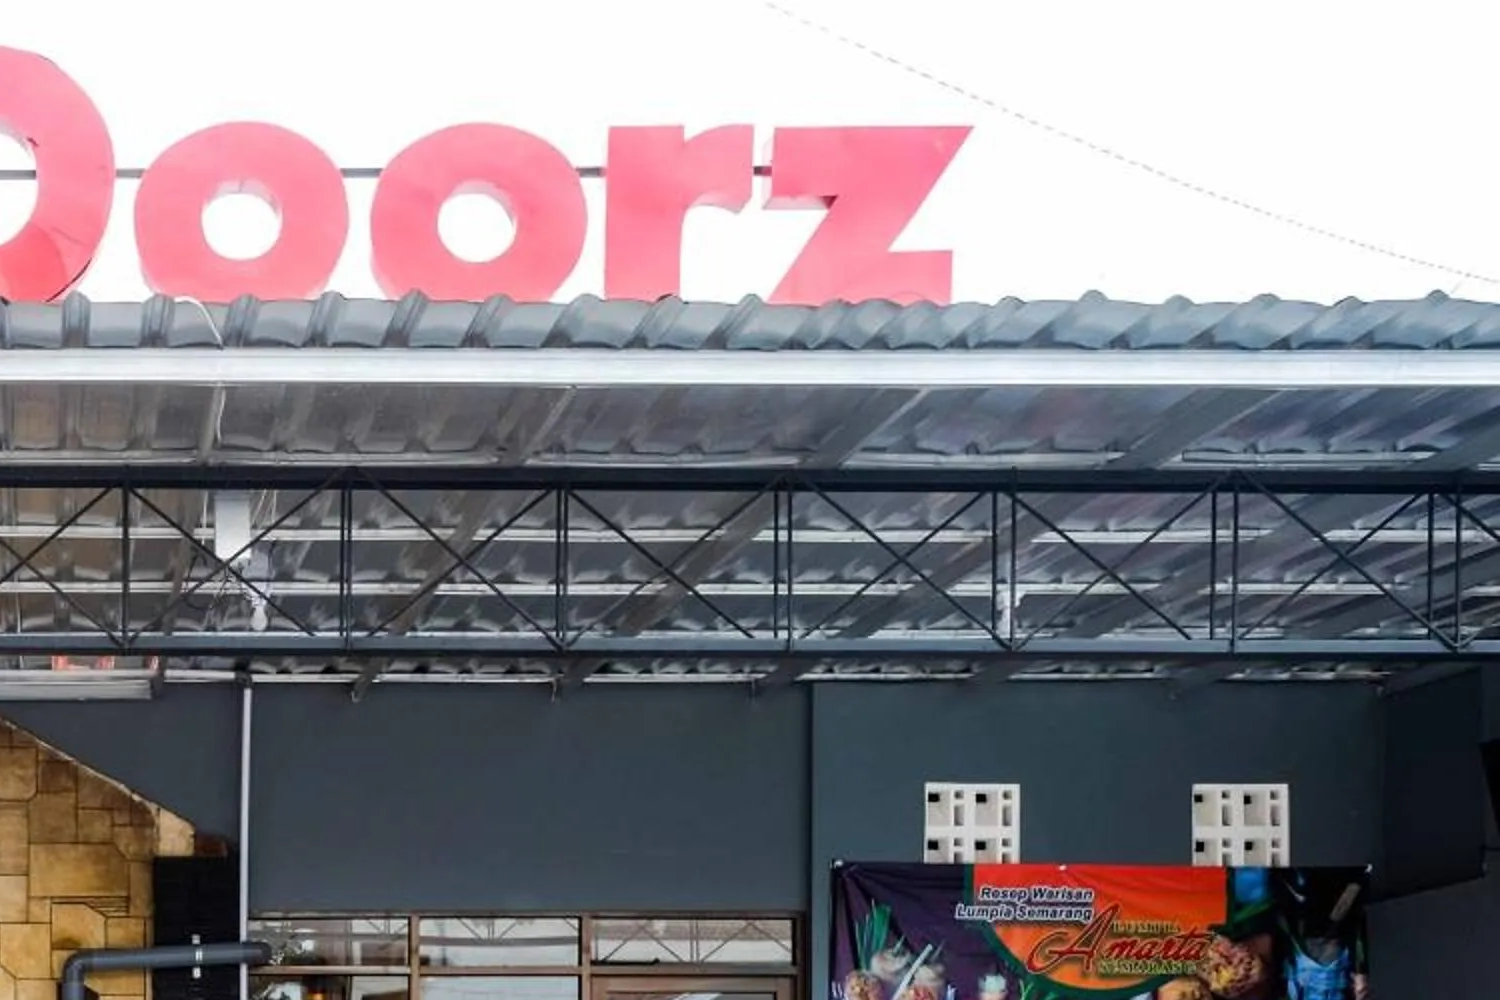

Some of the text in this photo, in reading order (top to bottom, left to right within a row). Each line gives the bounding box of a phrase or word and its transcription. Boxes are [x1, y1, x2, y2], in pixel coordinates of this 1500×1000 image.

[1030, 886, 1093, 902] Warisan
[956, 904, 1093, 921] Lumpia Semarang
[1027, 904, 1211, 972] Amarta
